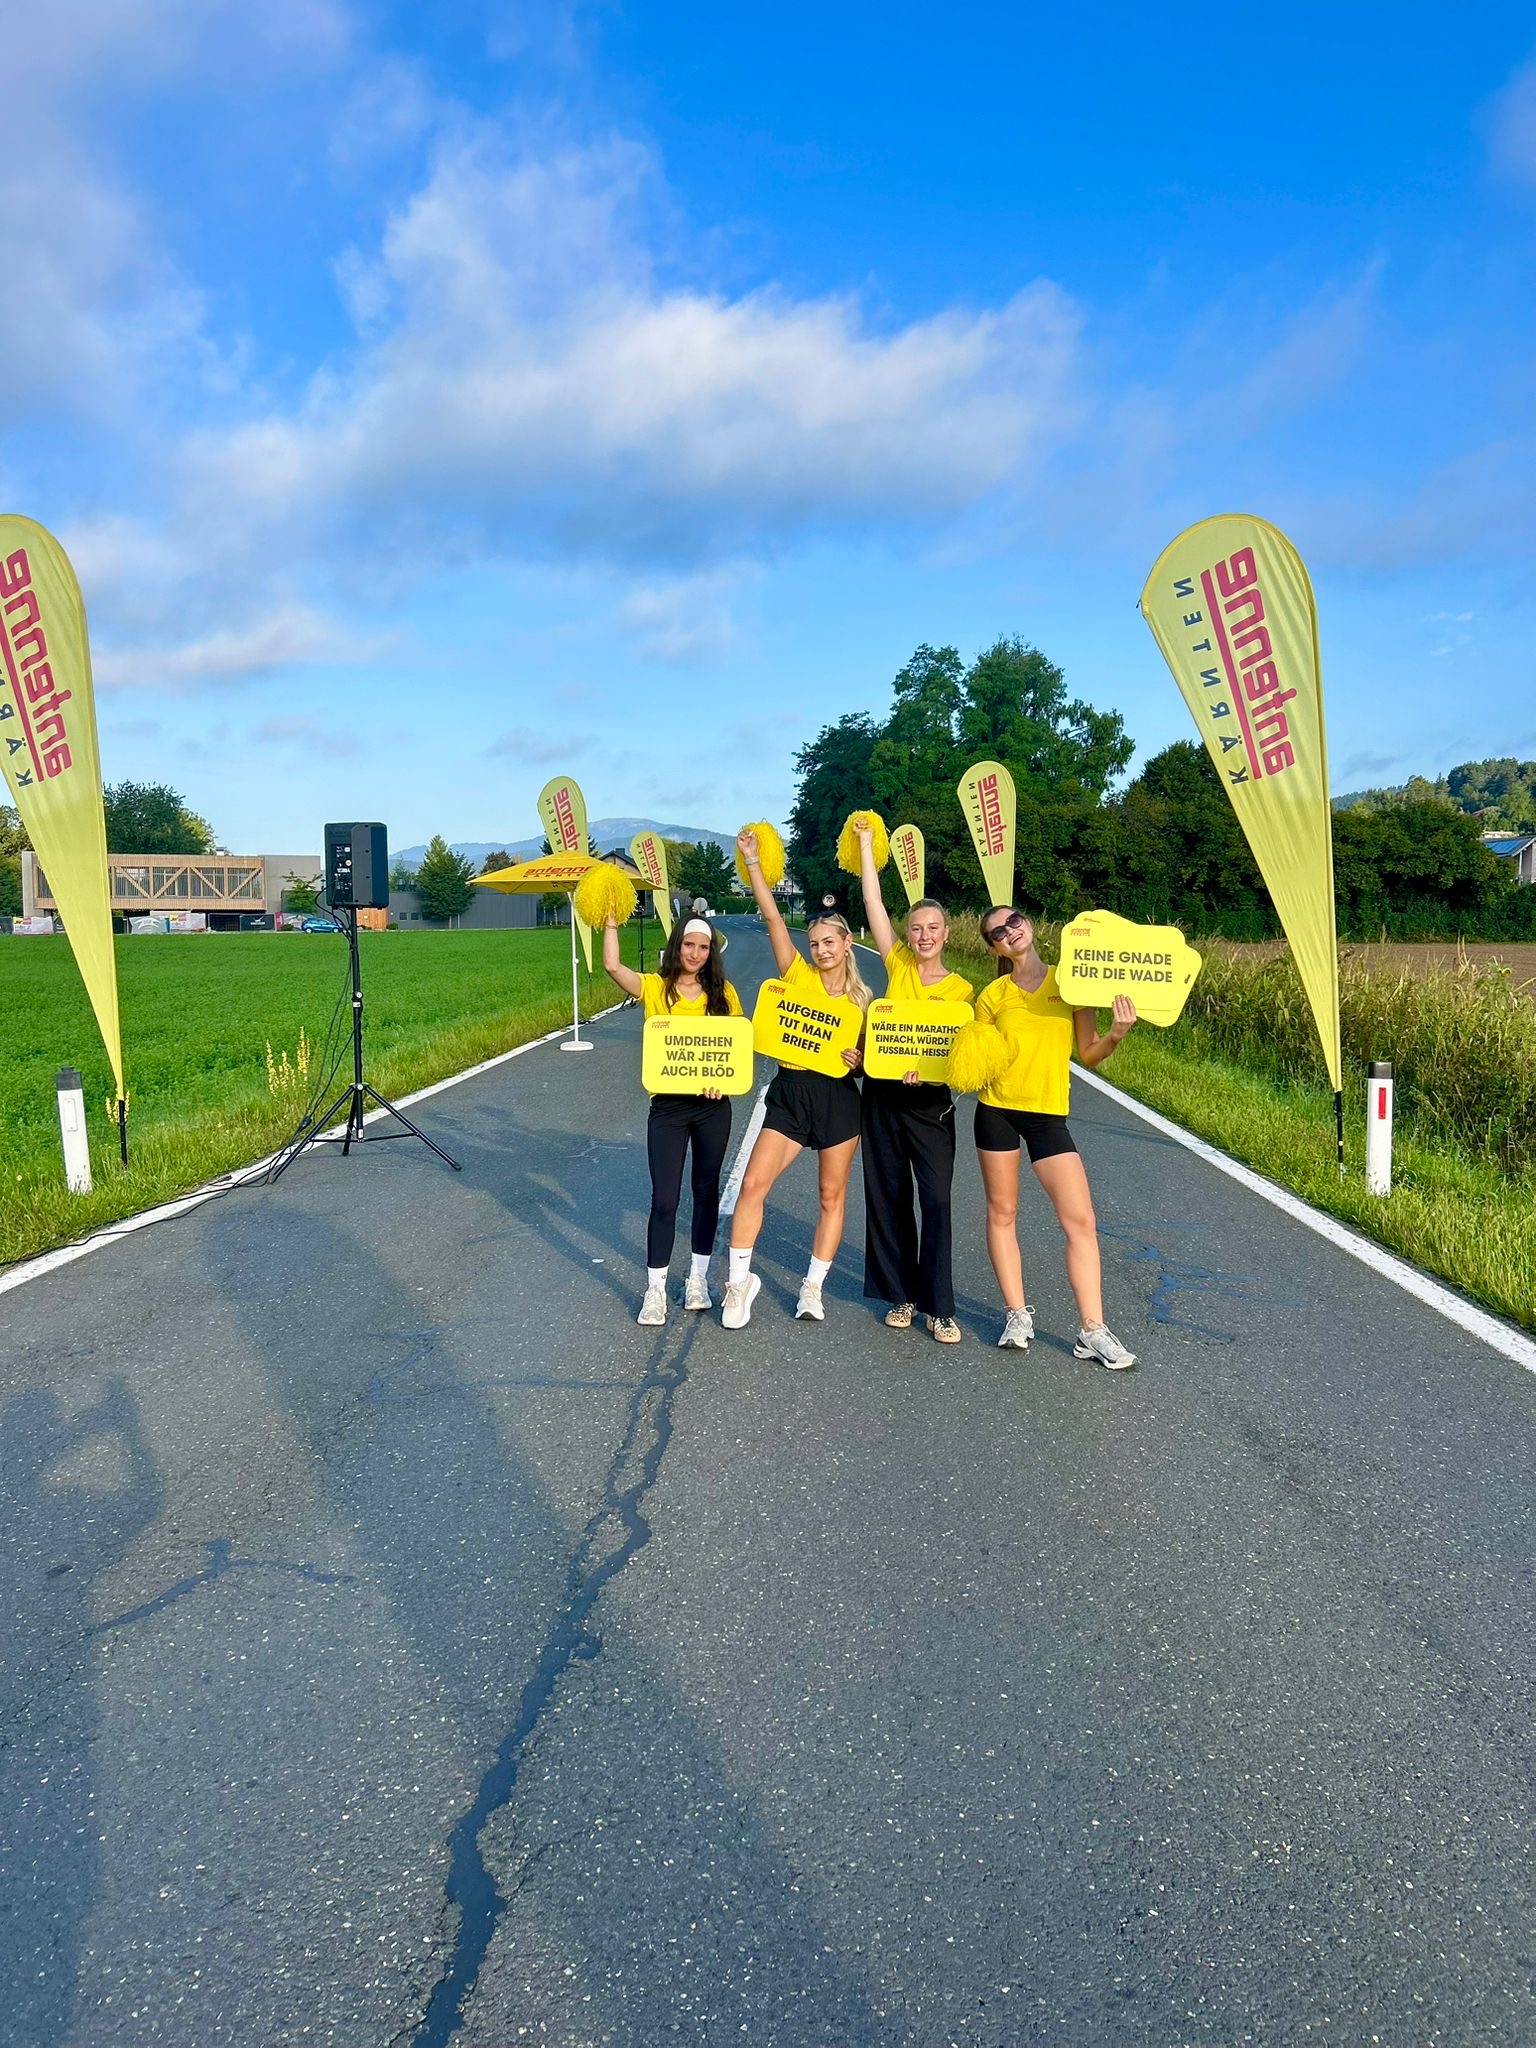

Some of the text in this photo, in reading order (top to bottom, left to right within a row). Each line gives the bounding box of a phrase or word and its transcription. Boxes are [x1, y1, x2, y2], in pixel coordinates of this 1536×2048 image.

[1074, 948, 1172, 966] KEINE GNADE
[1071, 963, 1098, 979] FÜR
[1102, 967, 1126, 980] DIE
[1129, 969, 1173, 983] WADE
[777, 1000, 841, 1028] AUFGEBEN
[779, 1015, 833, 1041] TUT MAN
[871, 1021, 960, 1034] WÄRE EIN MARATHO
[664, 1035, 733, 1047] UMDREHEN
[782, 1033, 822, 1054] BRIEFE
[875, 1034, 915, 1045] EINFACH,
[917, 1035, 949, 1045] WÜRDE
[666, 1048, 731, 1062] WÄR JETZT
[878, 1046, 919, 1056] FUSSBALL
[660, 1064, 735, 1077] AUCH BLÖD
